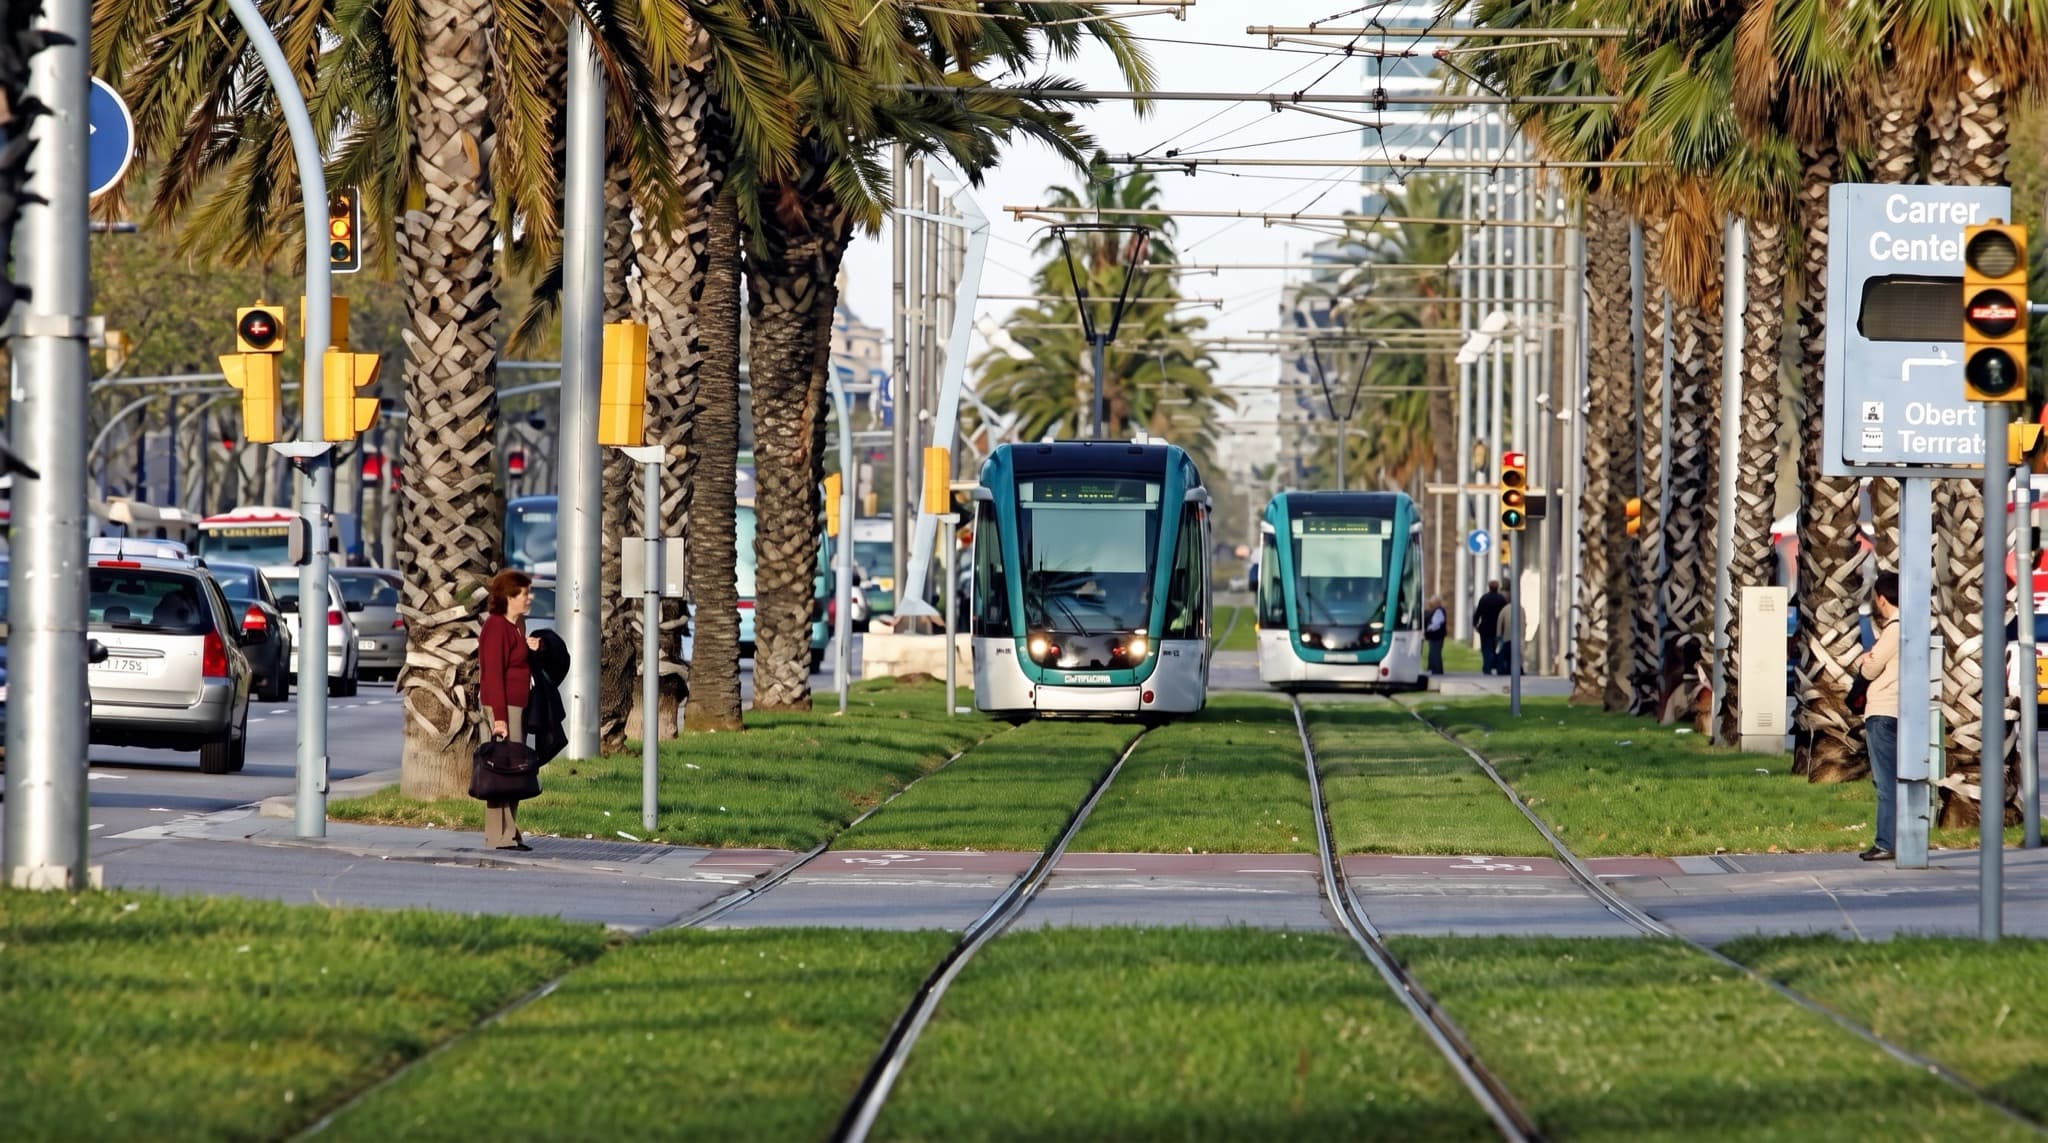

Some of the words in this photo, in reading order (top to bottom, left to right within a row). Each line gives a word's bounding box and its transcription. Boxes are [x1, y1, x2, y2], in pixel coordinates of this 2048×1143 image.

[1886, 193, 1980, 225] Carrer
[1869, 231, 1965, 262] Centel
[1905, 402, 1976, 426] Obert
